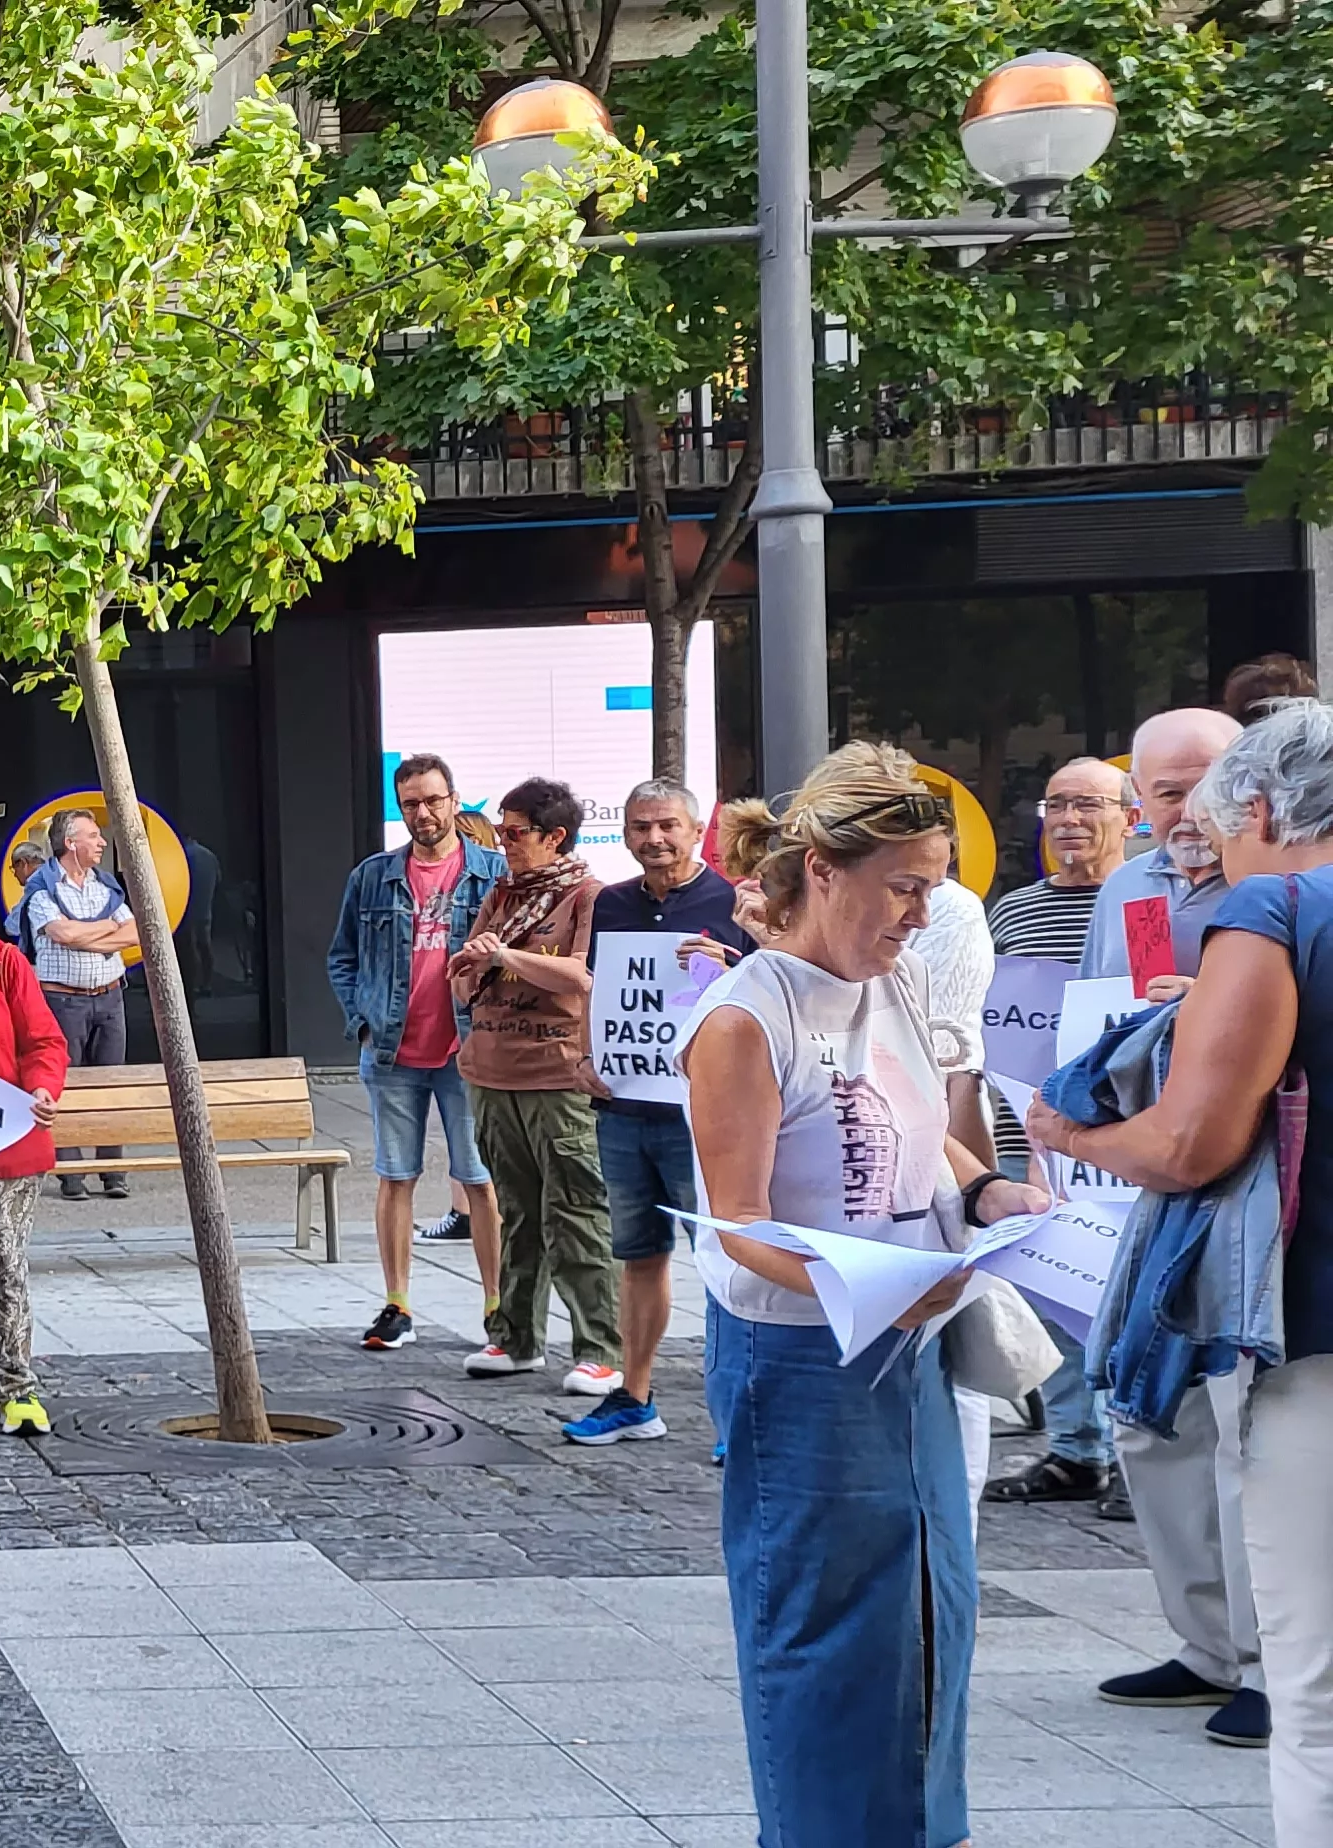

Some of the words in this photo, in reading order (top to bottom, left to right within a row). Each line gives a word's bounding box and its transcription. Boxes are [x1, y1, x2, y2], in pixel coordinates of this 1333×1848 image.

[627, 956, 656, 981] NI
[620, 987, 664, 1012] UN
[604, 1019, 677, 1045] PASO
[599, 1047, 677, 1077] ATRÁ
[1051, 1213, 1122, 1240] ENO
